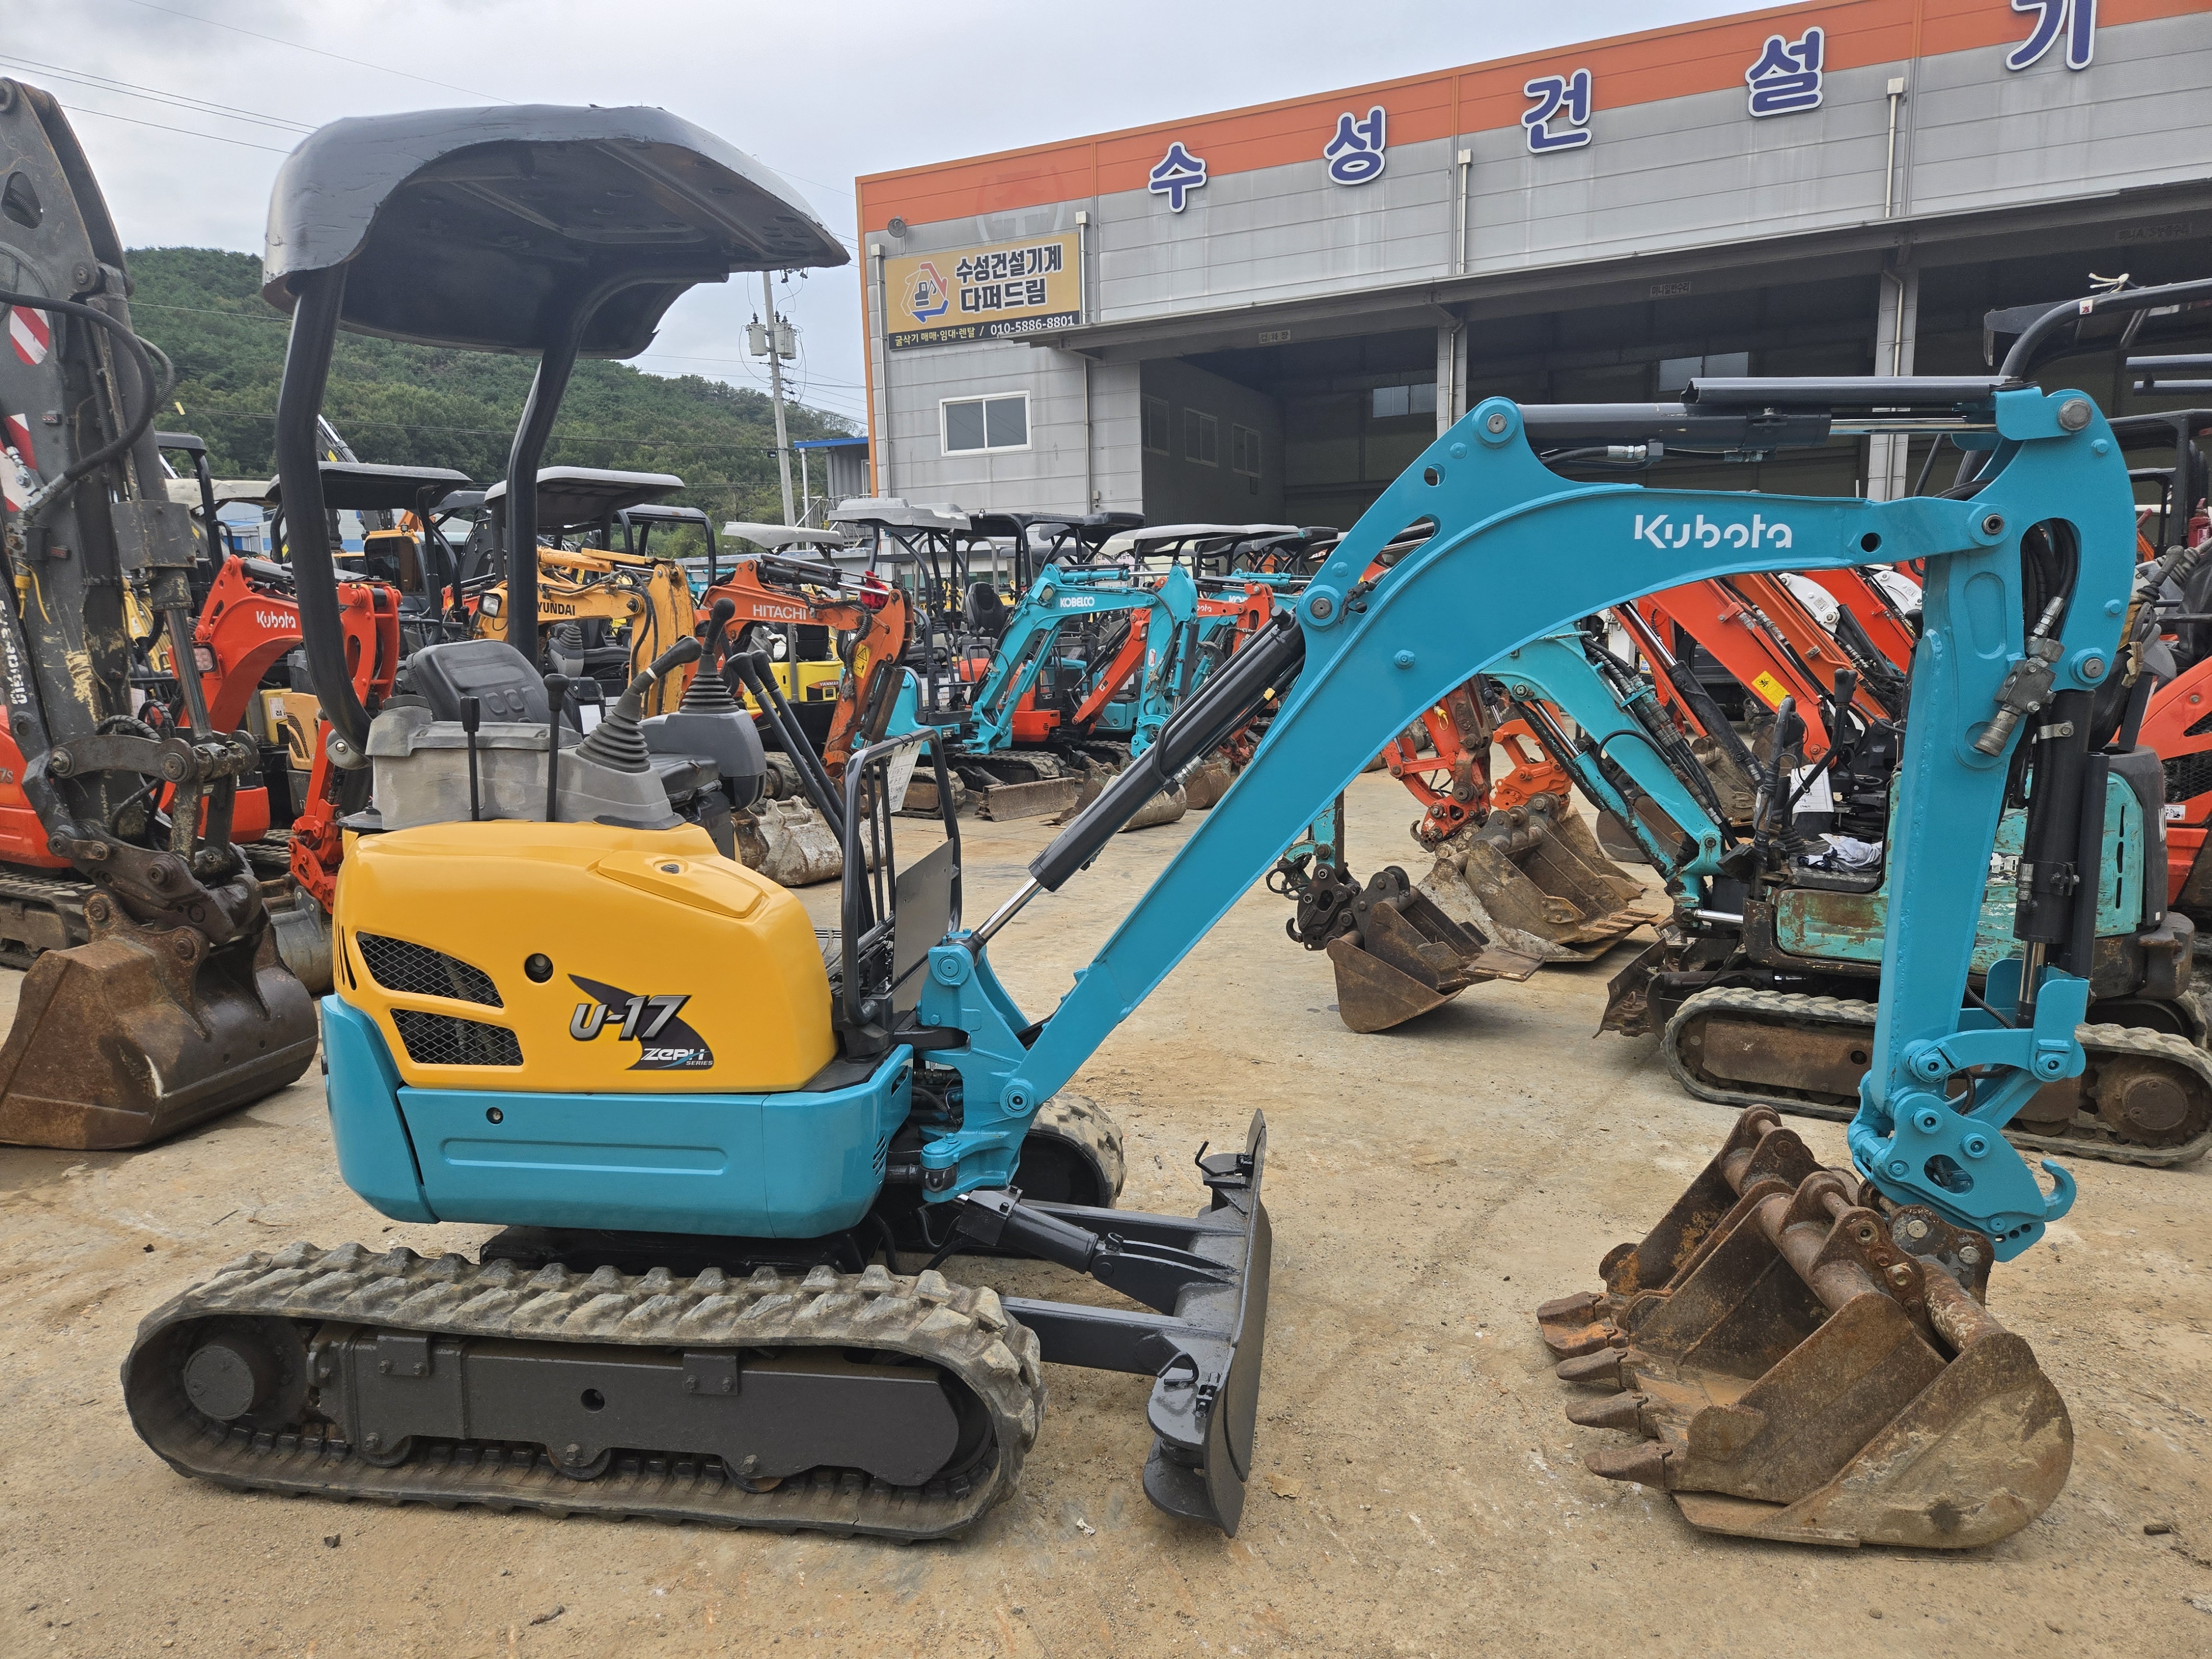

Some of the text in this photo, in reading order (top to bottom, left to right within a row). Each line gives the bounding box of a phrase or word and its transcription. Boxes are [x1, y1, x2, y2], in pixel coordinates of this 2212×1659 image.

[1149, 142, 1206, 212] 수
[1324, 105, 1385, 185] 성
[1522, 69, 1592, 153] 건
[1745, 27, 1824, 117] 설
[955, 243, 1063, 284] 수성건설기계
[960, 278, 1046, 313] 다퍼드림
[895, 332, 919, 347] 굴삭기
[990, 315, 1075, 335] 010-5886-8801
[1634, 514, 1792, 549] Kubota
[538, 601, 576, 616] YUNDAI
[753, 604, 806, 620] HITACHI
[1060, 596, 1095, 608] KOBELCO
[256, 611, 296, 629] Kubota
[569, 994, 692, 1041] U-17
